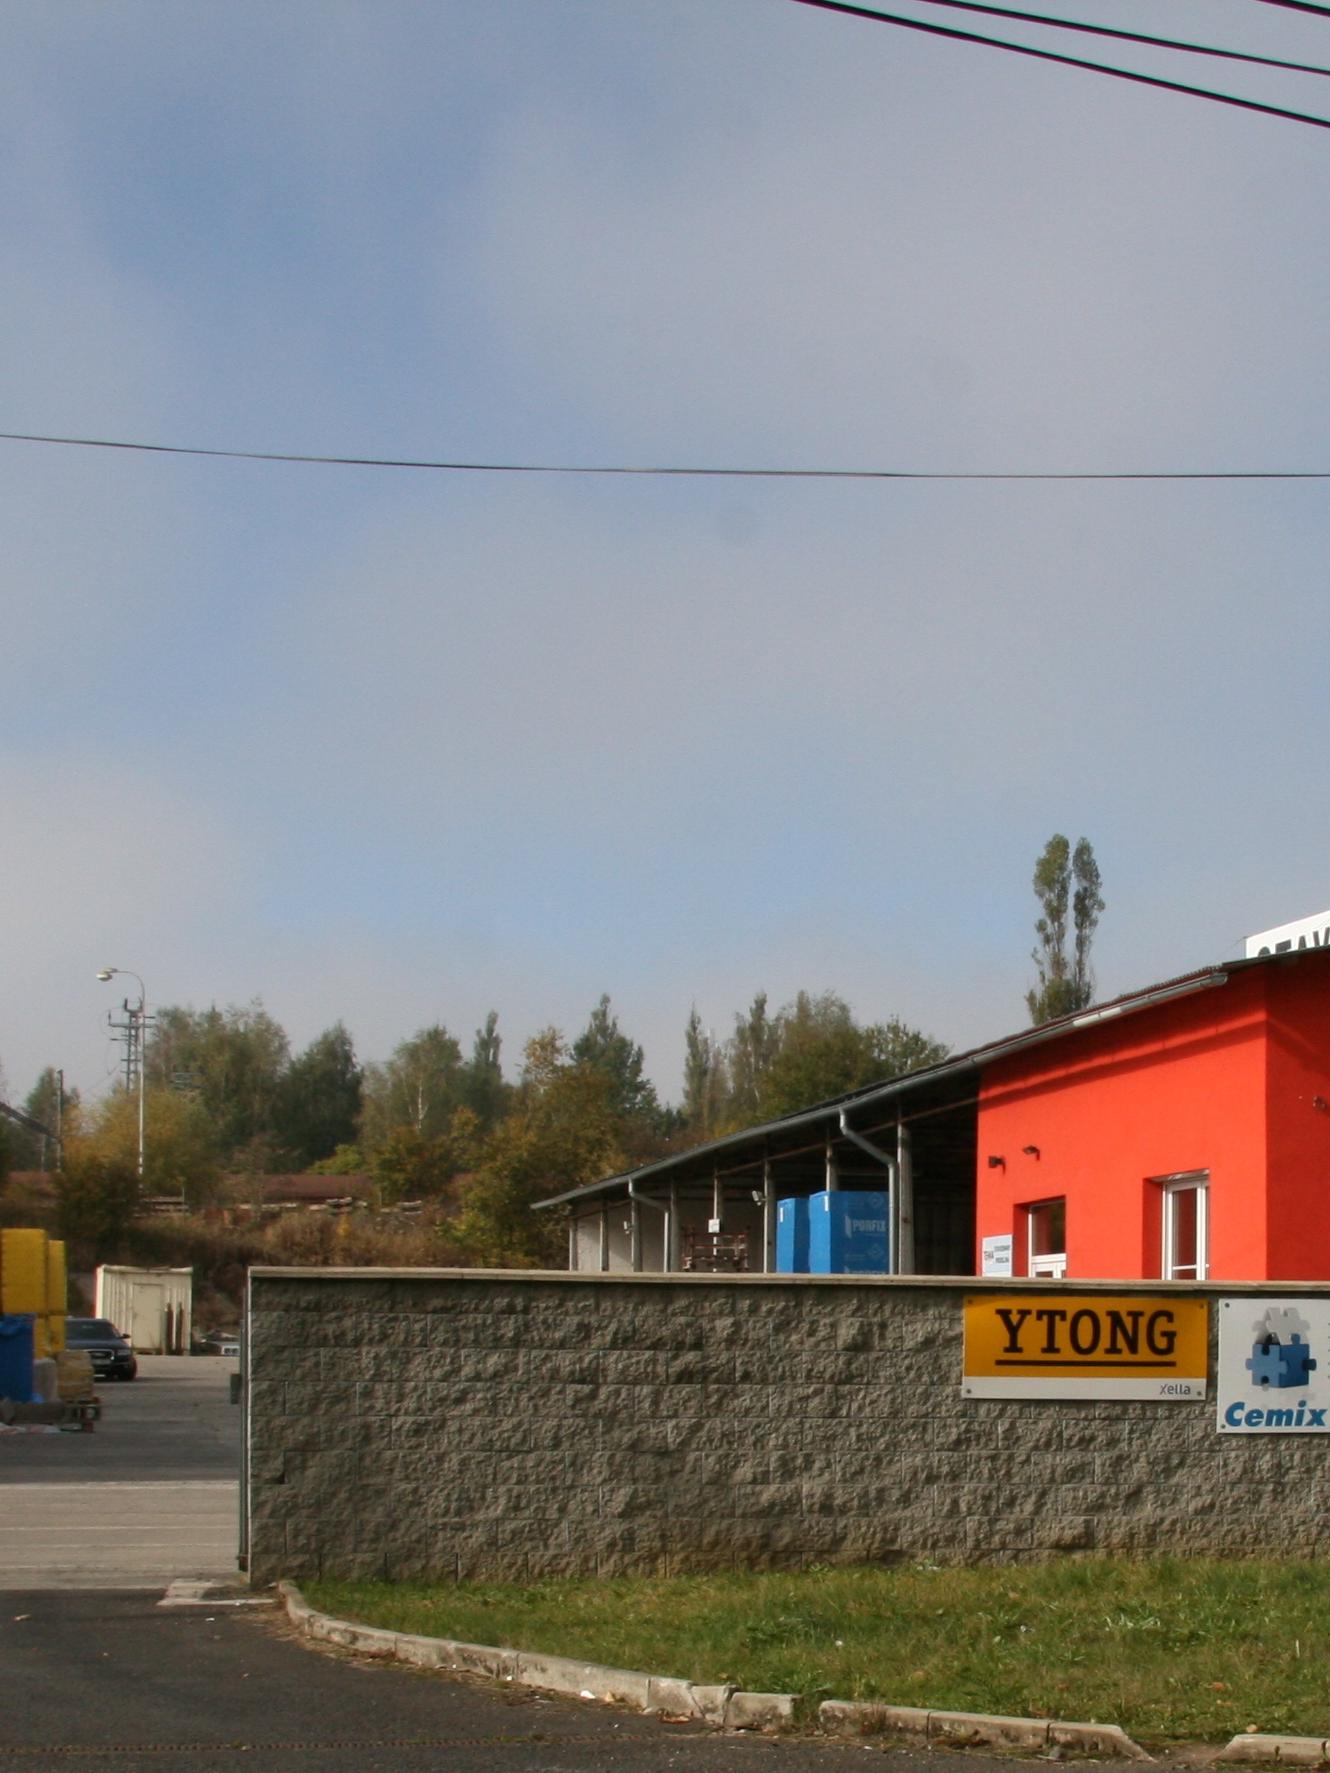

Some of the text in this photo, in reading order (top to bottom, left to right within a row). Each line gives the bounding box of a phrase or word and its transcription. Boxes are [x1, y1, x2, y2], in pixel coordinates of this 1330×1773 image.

[995, 1308, 1178, 1356] YTONG
[1160, 1383, 1191, 1396] Xella
[1225, 1399, 1328, 1427] Cemix
